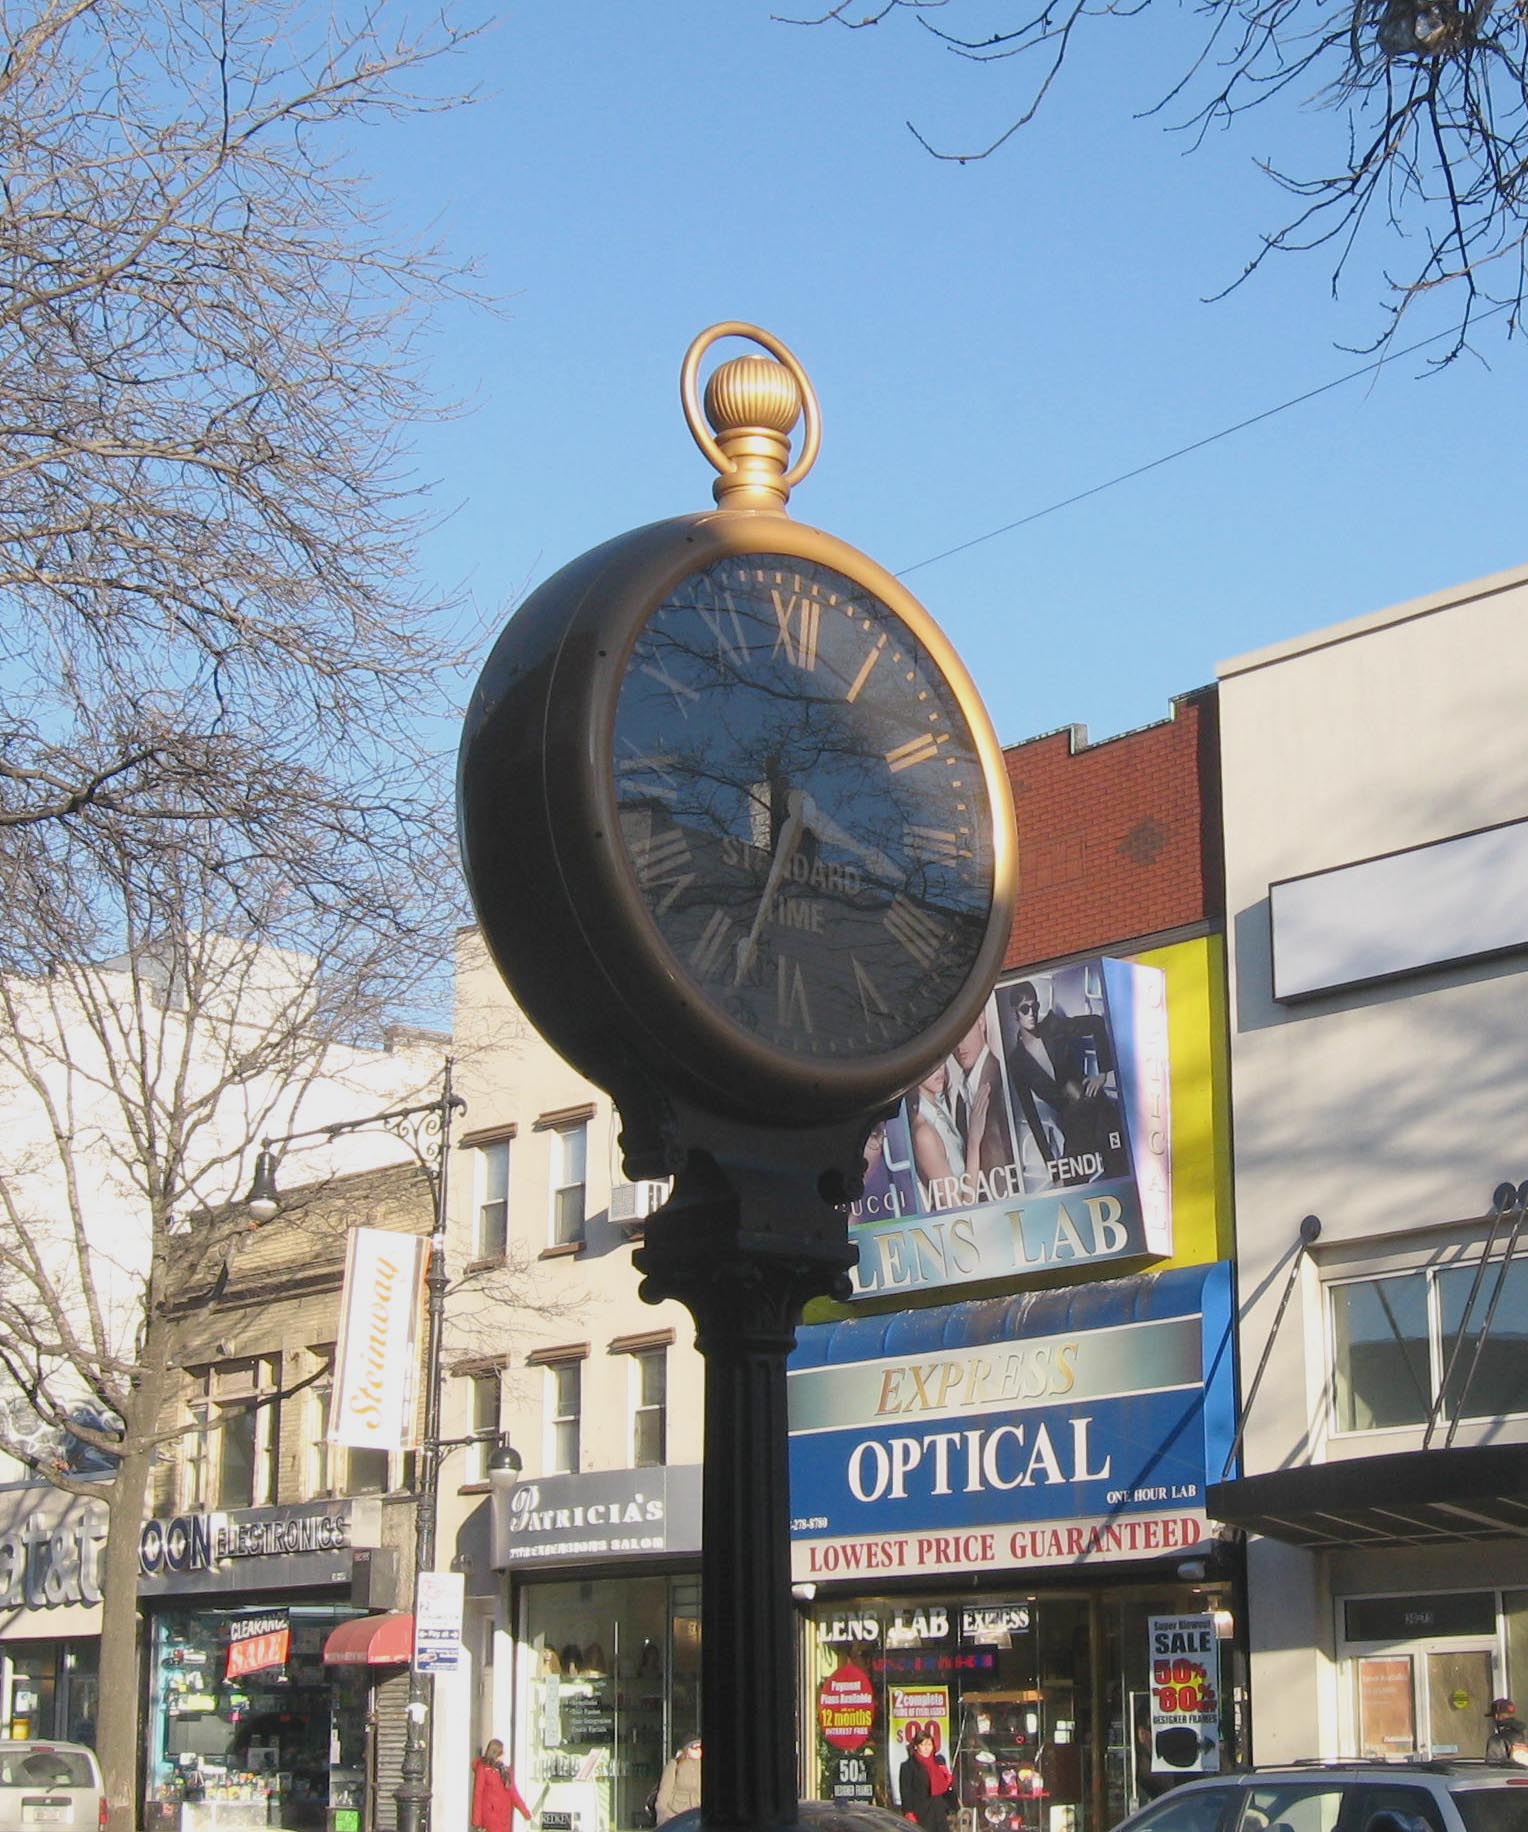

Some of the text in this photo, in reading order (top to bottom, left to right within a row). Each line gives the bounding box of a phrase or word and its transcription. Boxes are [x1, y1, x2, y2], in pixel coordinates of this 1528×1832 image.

[723, 835, 863, 896] STNDARD
[1047, 1152, 1104, 1181] FENDI
[832, 1190, 906, 1217] UCCI
[917, 1164, 1024, 1213] VERSACE
[848, 1195, 1129, 1294] LENS LAB
[874, 1343, 1080, 1416] EXPRESS
[847, 1417, 1111, 1502] OPTICAL
[510, 1485, 664, 1533] PATRICIA'S
[1106, 1484, 1197, 1504] ONE HOUR LAB
[137, 1514, 347, 1574] OON ELECTRONICS
[610, 1536, 664, 1551] SALON
[808, 1518, 1201, 1573] LOWEST PRICE GUARANTEED
[819, 1606, 1030, 1642] LENS LAB EXPRESS
[1154, 1630, 1212, 1654] SALE
[228, 1633, 284, 1673] SALE
[1153, 1658, 1207, 1685] 50%
[821, 1707, 872, 1726] 12 months
[895, 1690, 944, 1708] 2 complete
[1153, 1714, 1217, 1724] DESIGNER FRAMES
